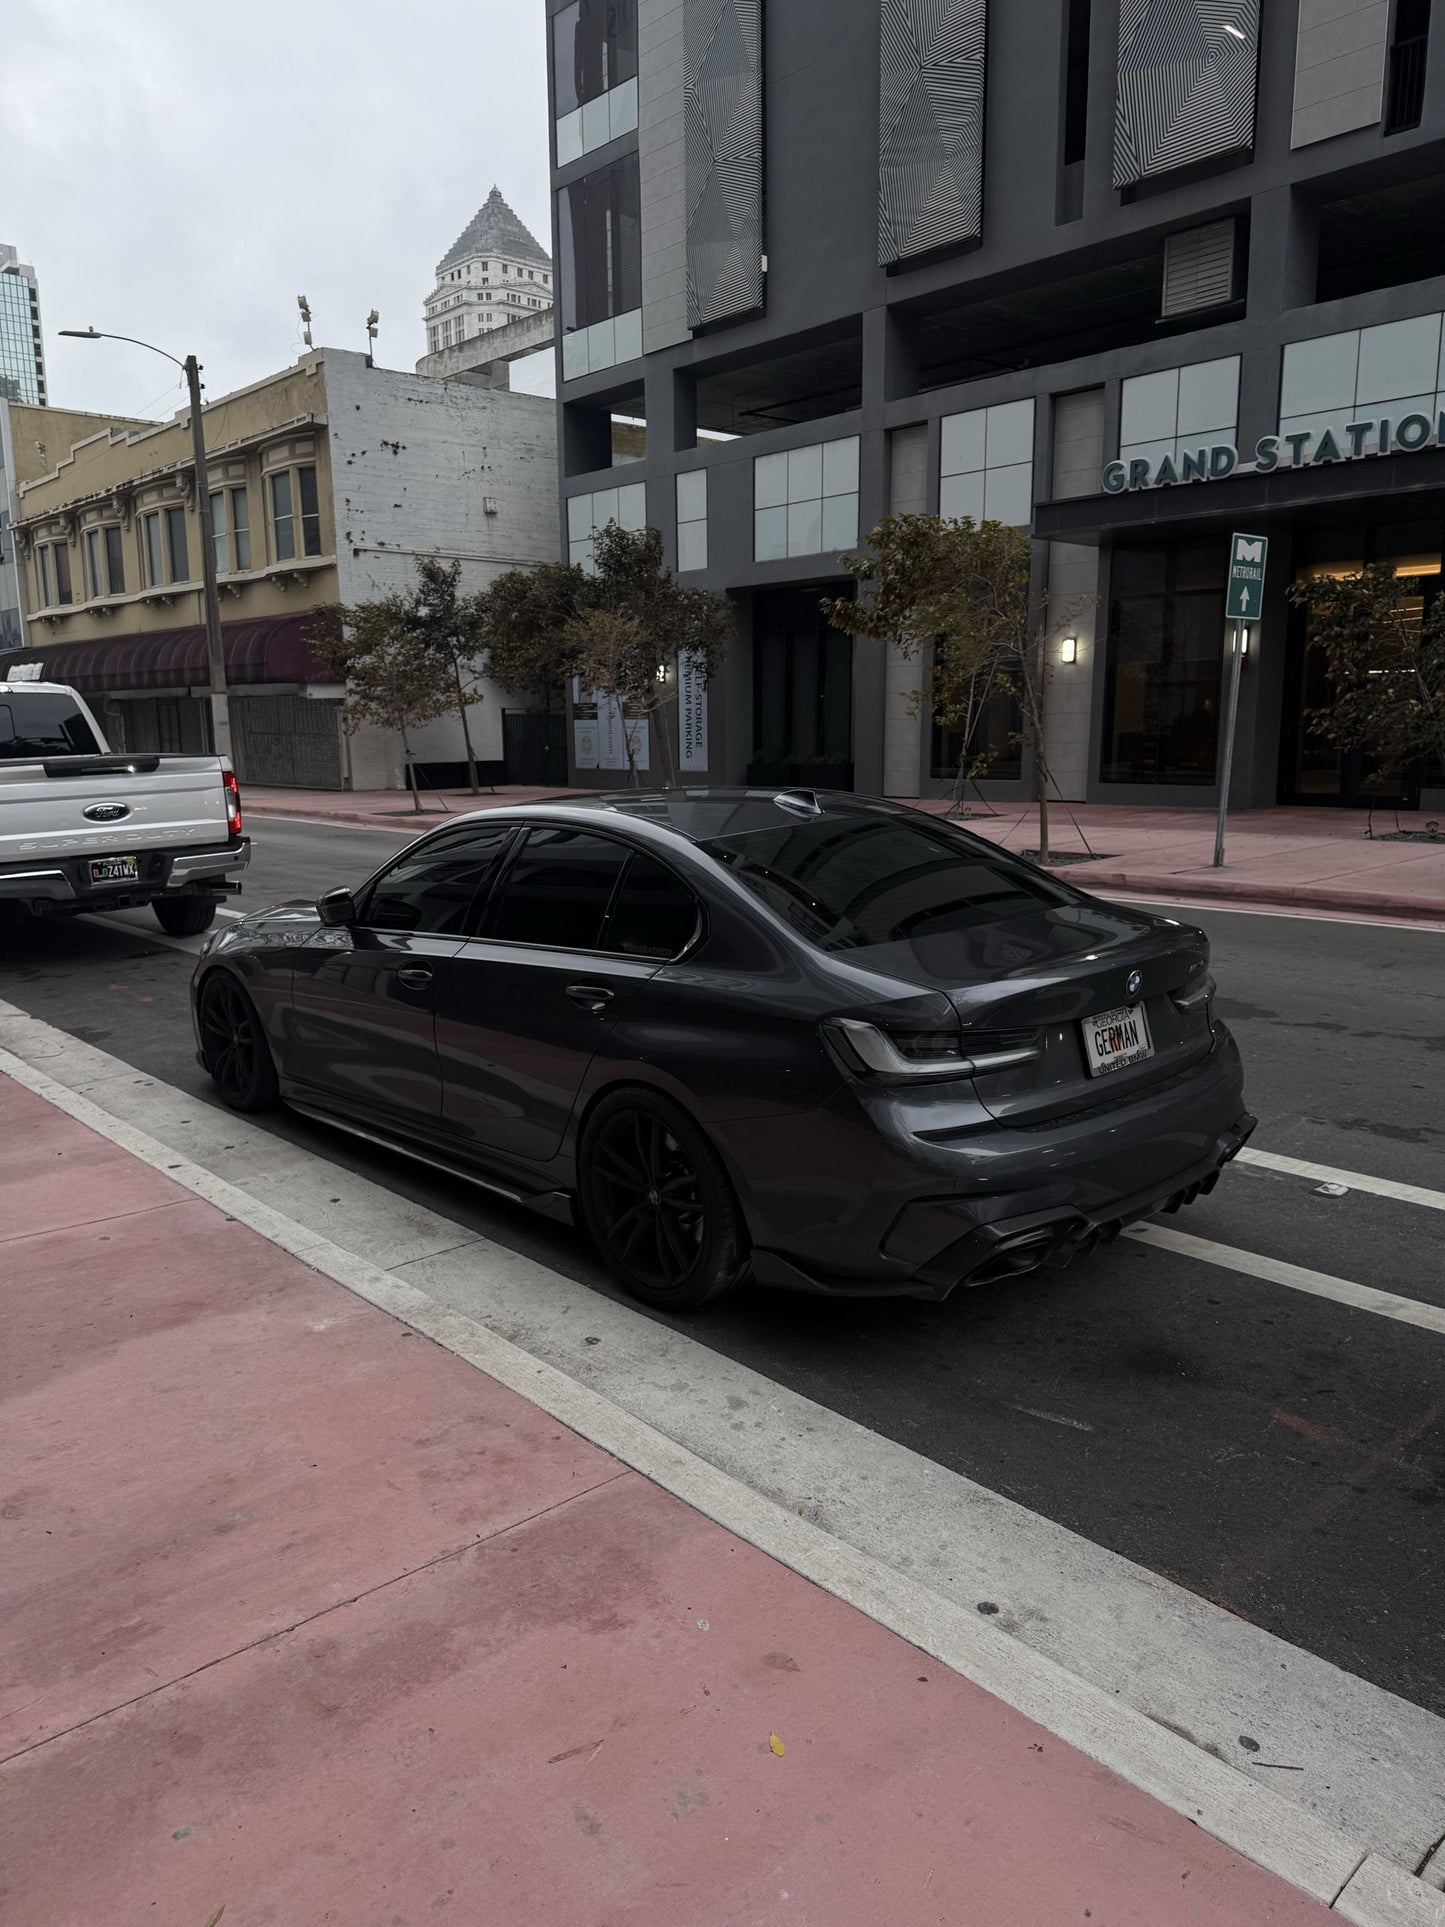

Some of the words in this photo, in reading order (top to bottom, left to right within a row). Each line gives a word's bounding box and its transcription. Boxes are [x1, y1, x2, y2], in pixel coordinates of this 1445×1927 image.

[1101, 444, 1238, 493] GRAND
[1231, 565, 1261, 581] METRORAIL
[695, 664, 703, 749] ELF-STORAGE
[685, 708, 693, 759] PARKING
[95, 805, 121, 818] Ford
[19, 834, 119, 851] SUPER
[126, 827, 196, 841] DUTY
[1095, 1011, 1131, 1029] GEORGIA
[1094, 1019, 1140, 1057] GERMAN
[1099, 1058, 1127, 1074] UNITED
[1128, 1048, 1148, 1064] BMW
